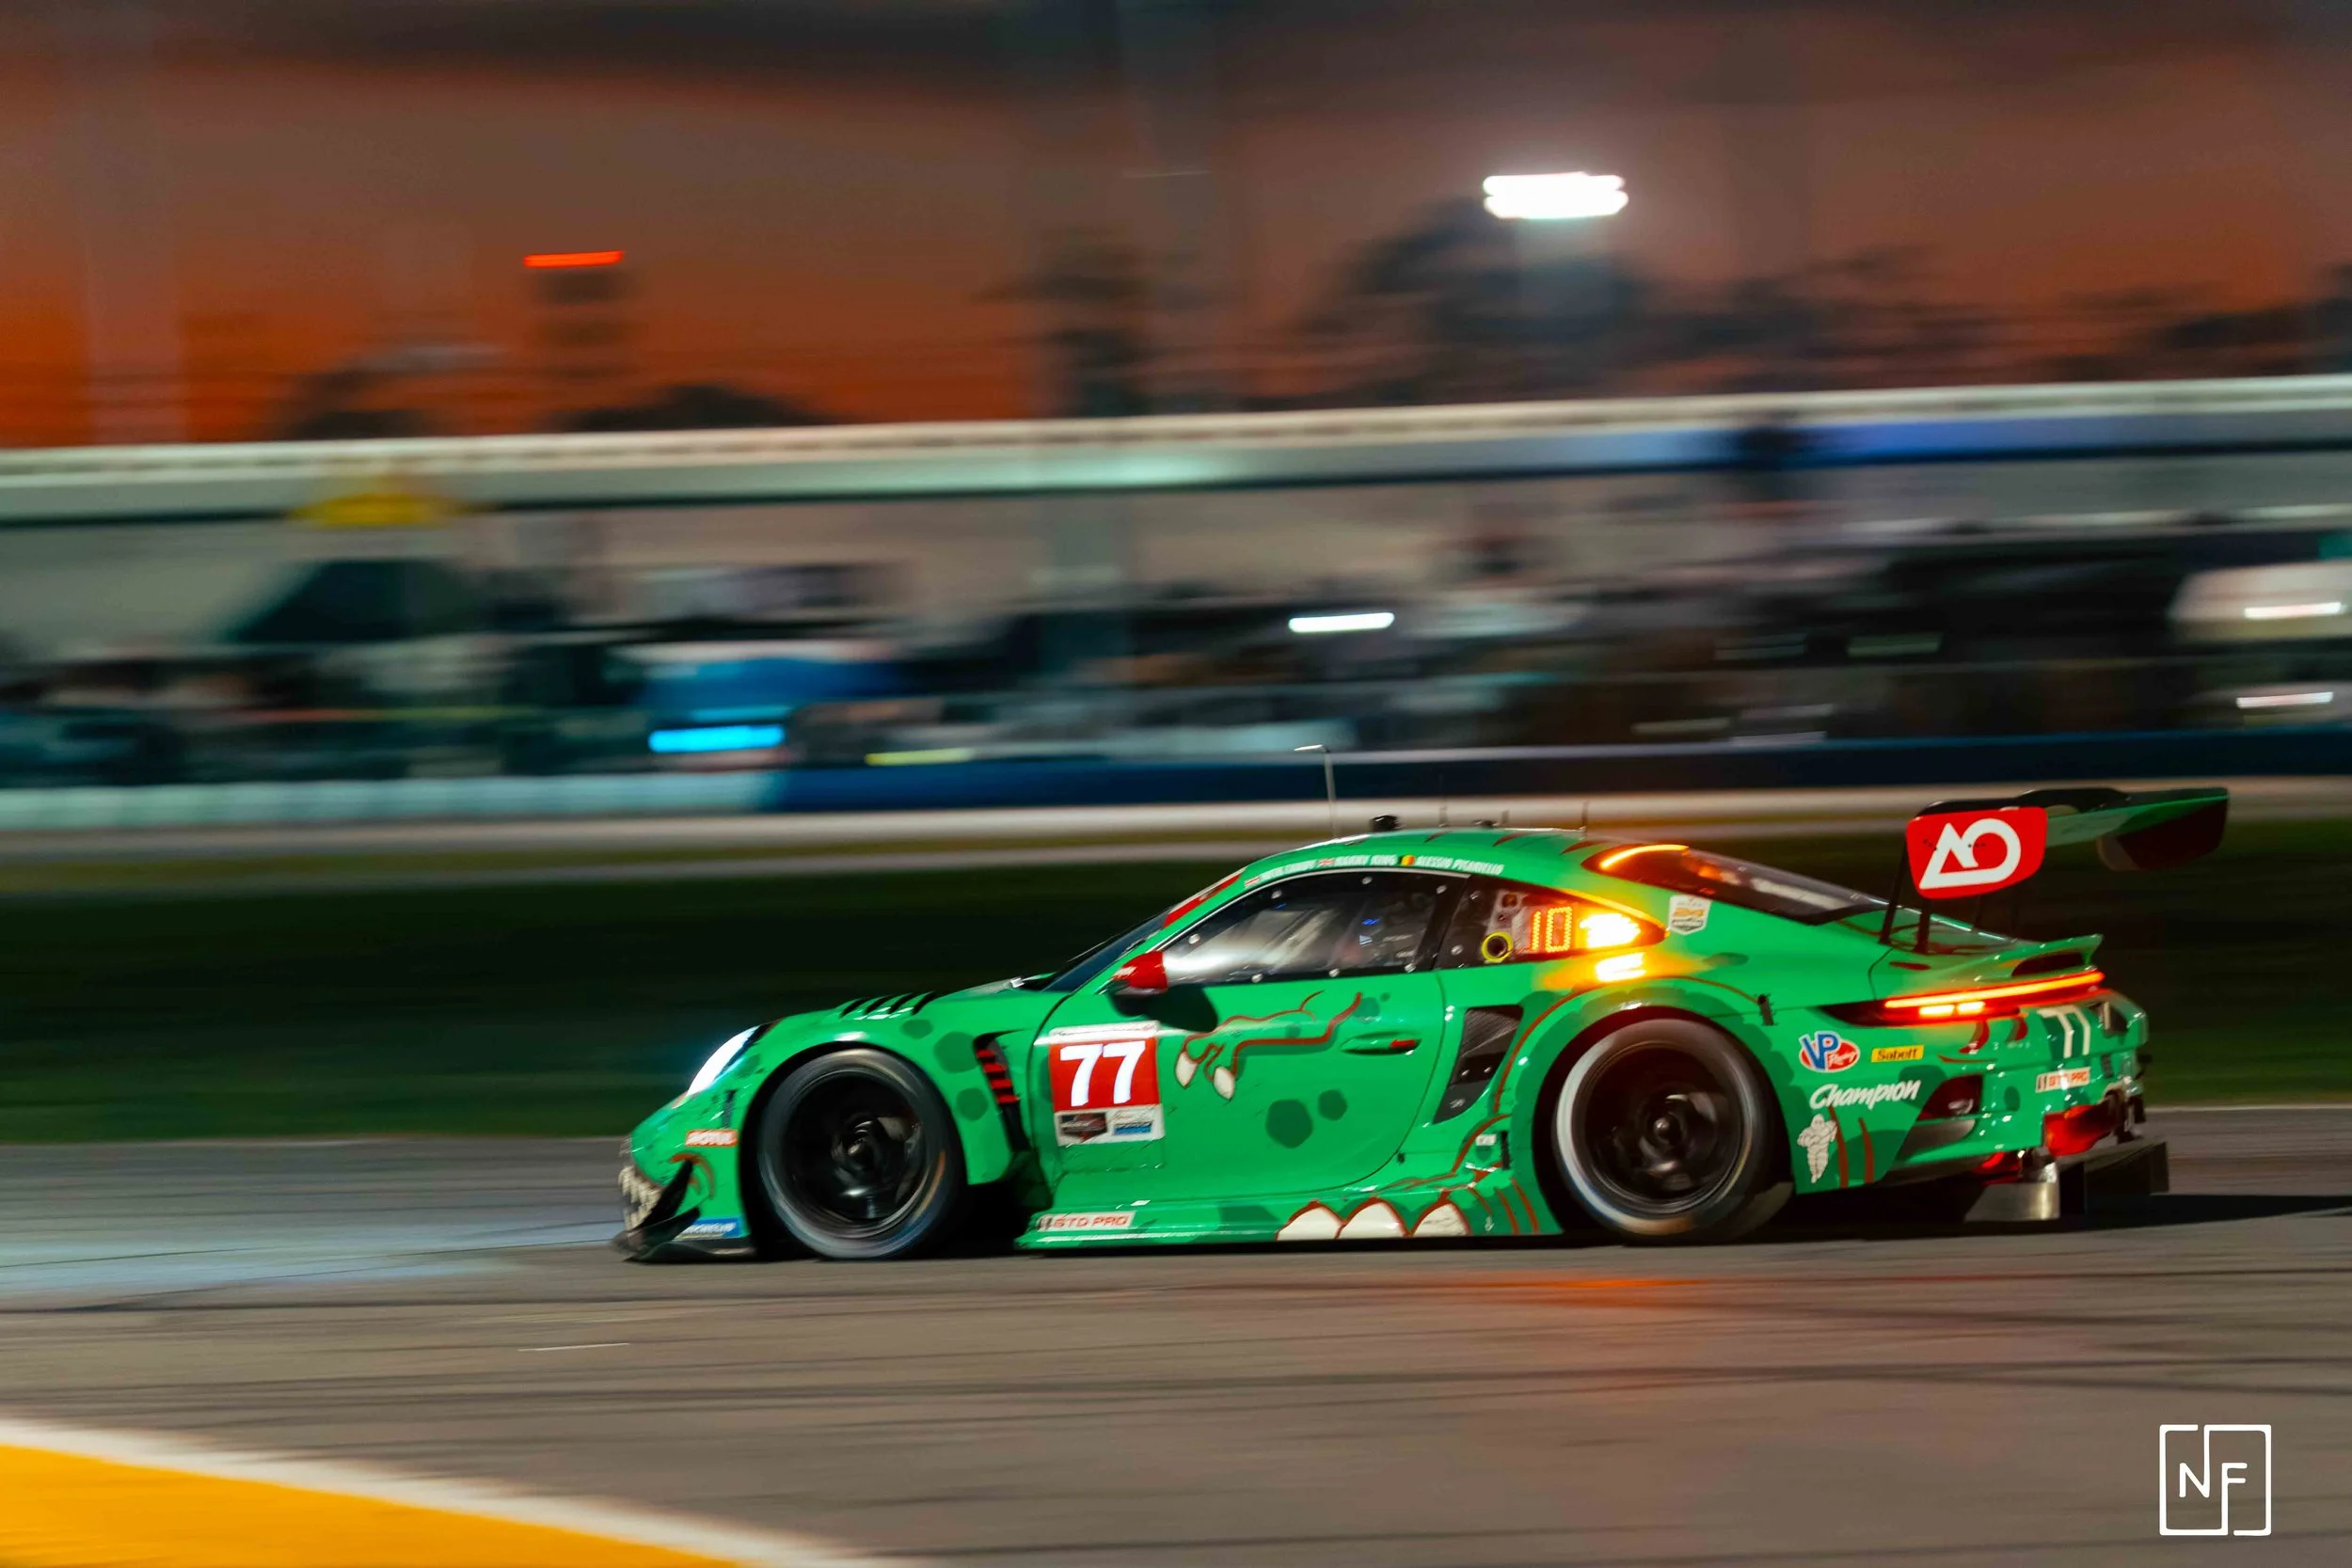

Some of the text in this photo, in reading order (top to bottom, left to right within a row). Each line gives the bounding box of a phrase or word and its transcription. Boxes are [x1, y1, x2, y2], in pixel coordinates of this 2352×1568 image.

[1919, 817, 2022, 890] AO
[1531, 906, 1573, 952] 10
[1799, 1031, 1840, 1071] VP
[2037, 1005, 2090, 1059] 77
[1060, 1040, 1146, 1107] 77
[1809, 1079, 1921, 1110] Champion
[1091, 1215, 1128, 1227] PRO
